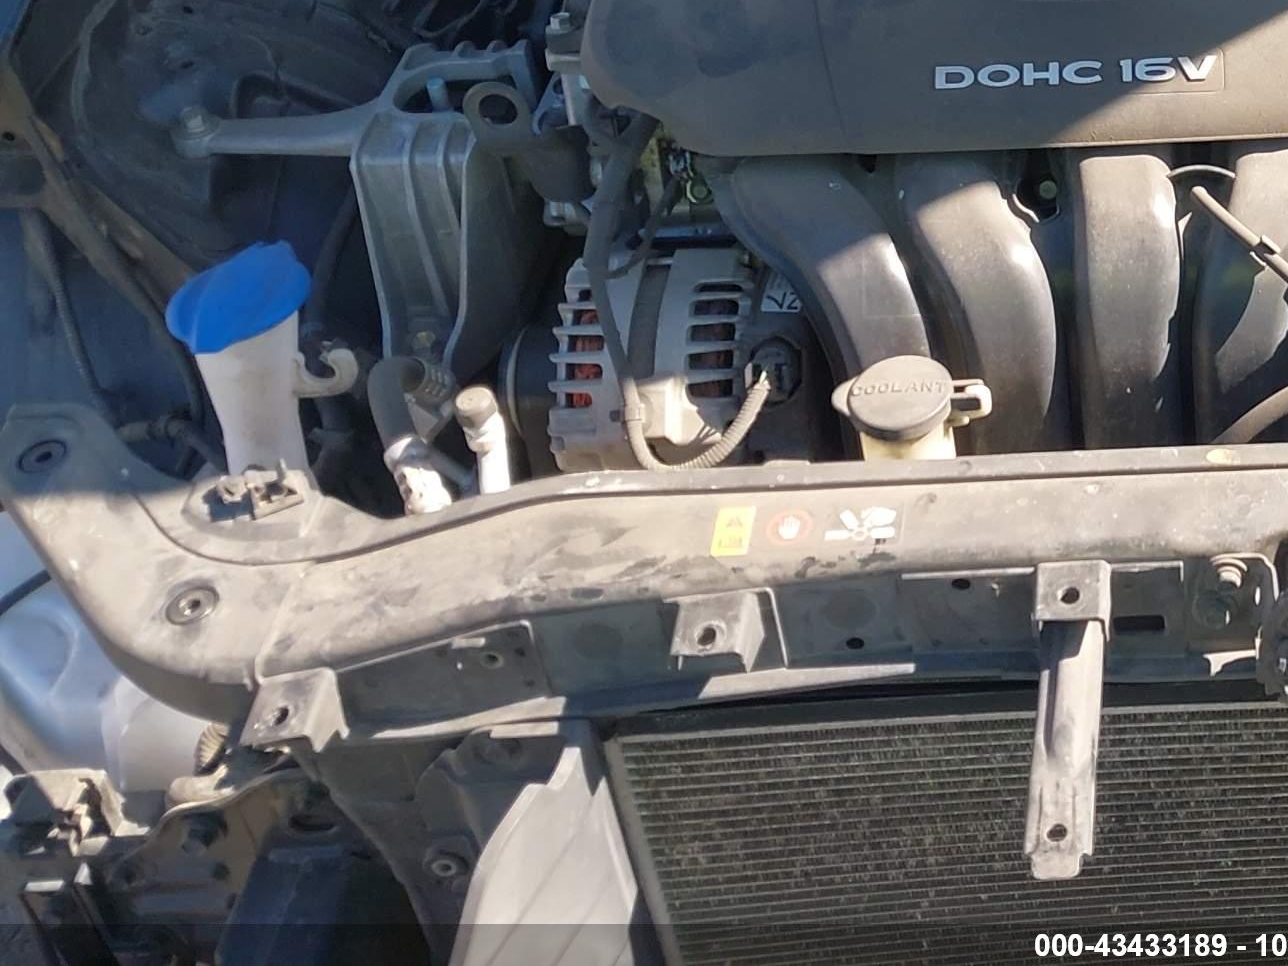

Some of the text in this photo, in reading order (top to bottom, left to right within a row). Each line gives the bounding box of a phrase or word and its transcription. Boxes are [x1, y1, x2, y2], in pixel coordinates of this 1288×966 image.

[934, 55, 1218, 90] DOHC 16V
[851, 379, 947, 397] COOLANT
